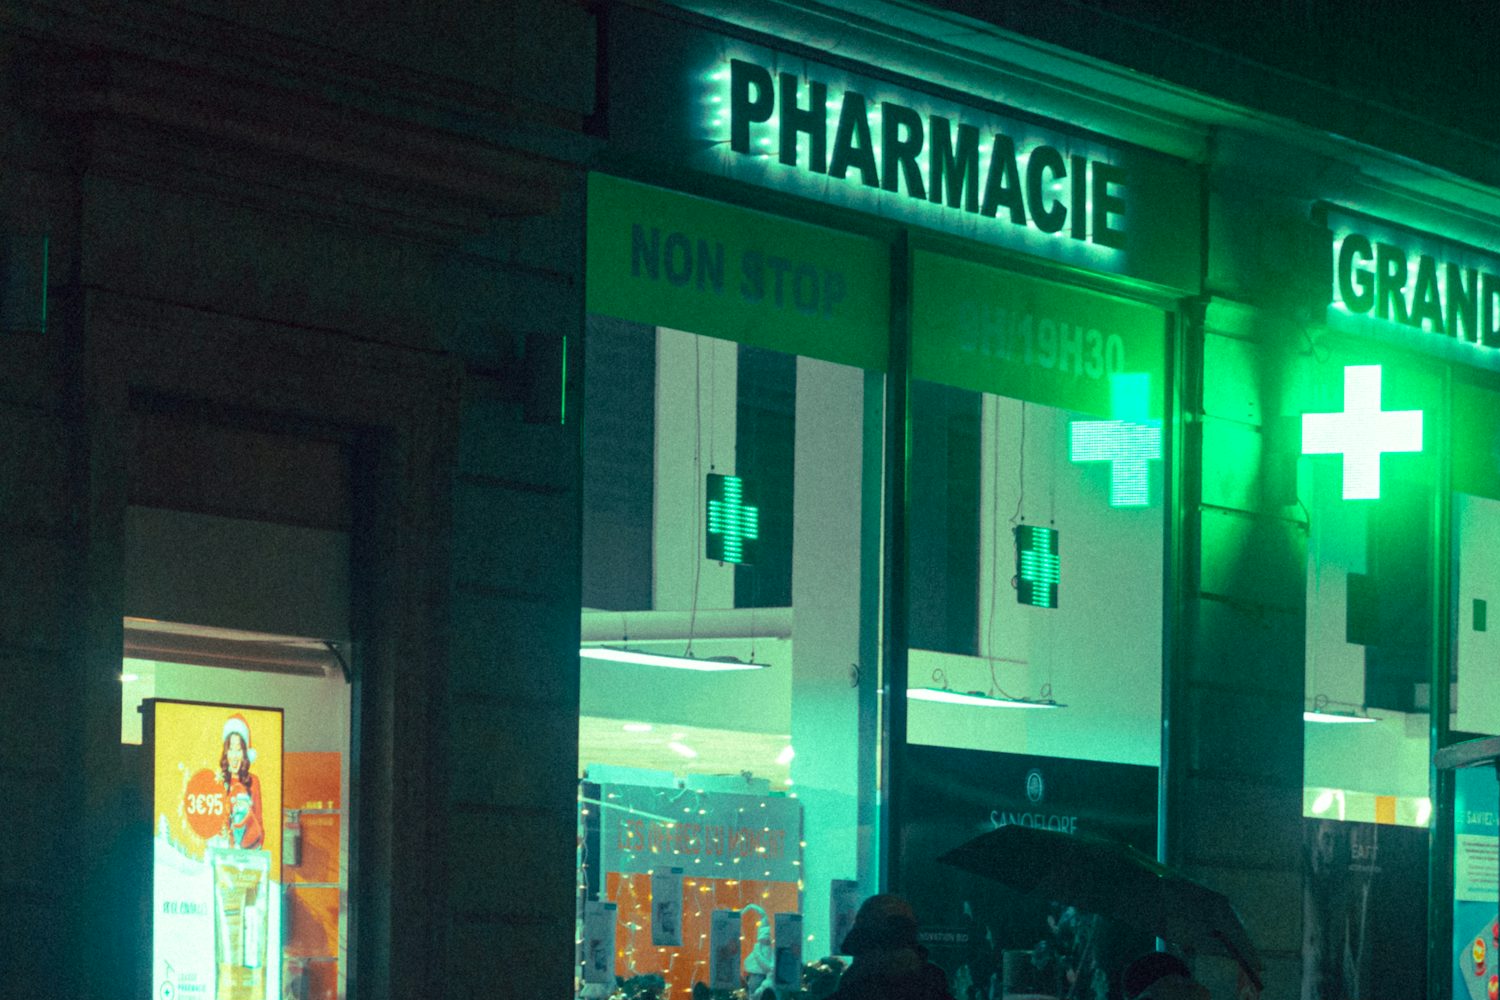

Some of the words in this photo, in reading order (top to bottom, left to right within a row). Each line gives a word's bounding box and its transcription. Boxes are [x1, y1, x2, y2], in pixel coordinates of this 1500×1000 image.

[729, 58, 1128, 250] PHARMACIE
[630, 223, 725, 295] NON
[740, 250, 846, 320] STOP
[187, 794, 224, 816] 3€95
